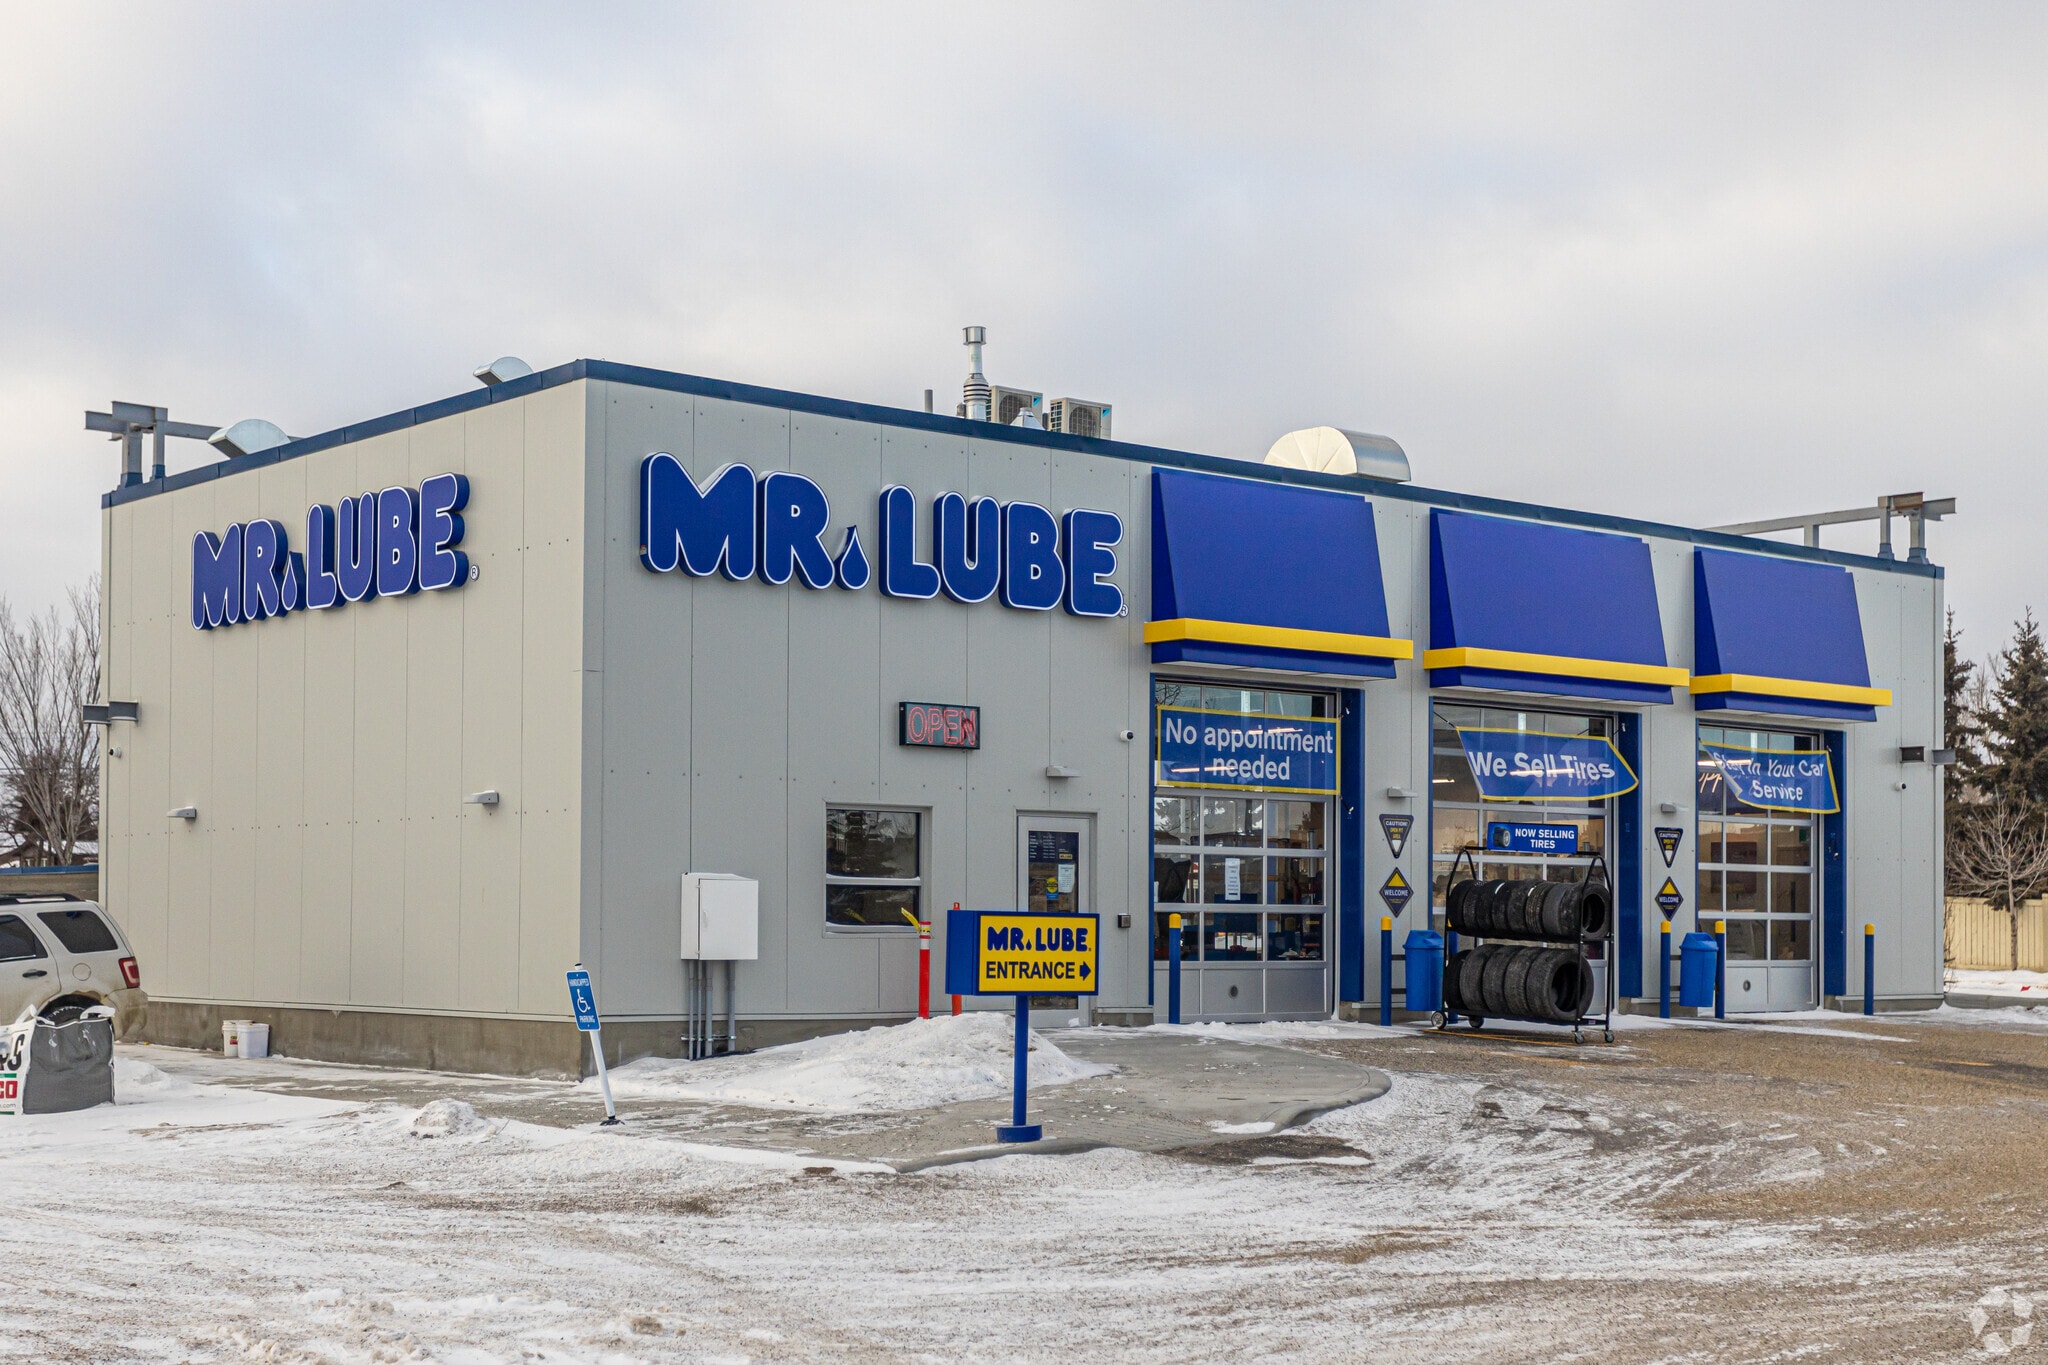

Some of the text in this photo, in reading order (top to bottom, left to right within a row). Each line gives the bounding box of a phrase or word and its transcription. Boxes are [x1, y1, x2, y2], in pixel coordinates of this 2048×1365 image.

[306, 472, 471, 610] LUBE
[879, 484, 1124, 618] LUBE
[907, 706, 977, 746] OPEN
[1165, 717, 1334, 754] No appointment
[1213, 755, 1290, 780] needed
[1468, 751, 1615, 780] We Sell Tires
[1768, 759, 1795, 777] Your
[1798, 760, 1825, 777] Car
[1752, 780, 1804, 801] Service
[1515, 828, 1575, 839] NOW SELLING
[1530, 839, 1556, 849] TIRES
[1035, 927, 1088, 952] LUBE
[986, 961, 1076, 979] ENTRANCE
